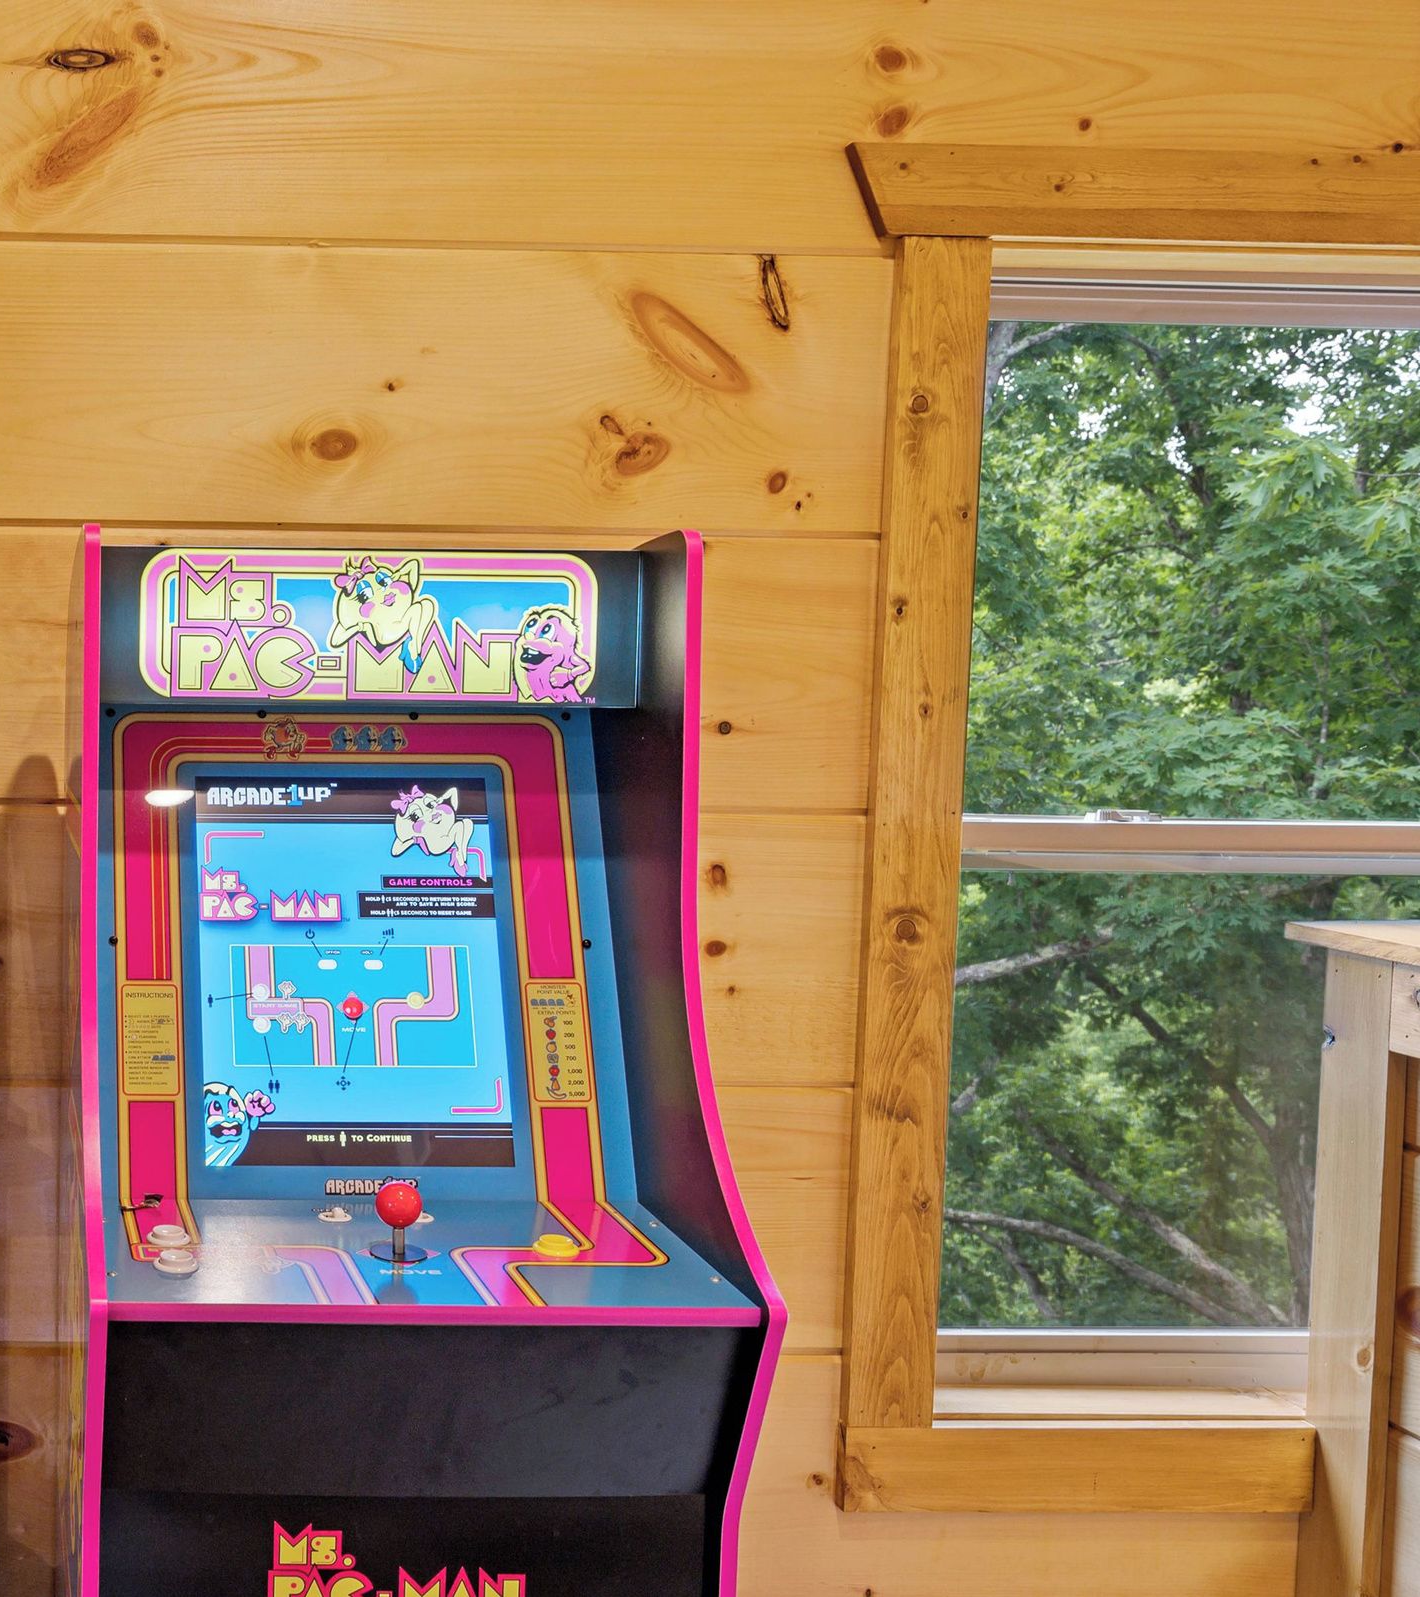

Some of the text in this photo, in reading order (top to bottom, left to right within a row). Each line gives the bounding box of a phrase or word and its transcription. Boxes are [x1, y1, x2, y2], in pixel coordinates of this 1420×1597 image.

[180, 564, 291, 626] Ms.
[173, 622, 517, 698] PAC-MAN
[202, 868, 247, 891] Ms.
[201, 892, 340, 920] PAC-MAN
[306, 1134, 335, 1142] PRESS
[366, 1134, 412, 1142] CONTINUE
[275, 1525, 355, 1568] Ms.
